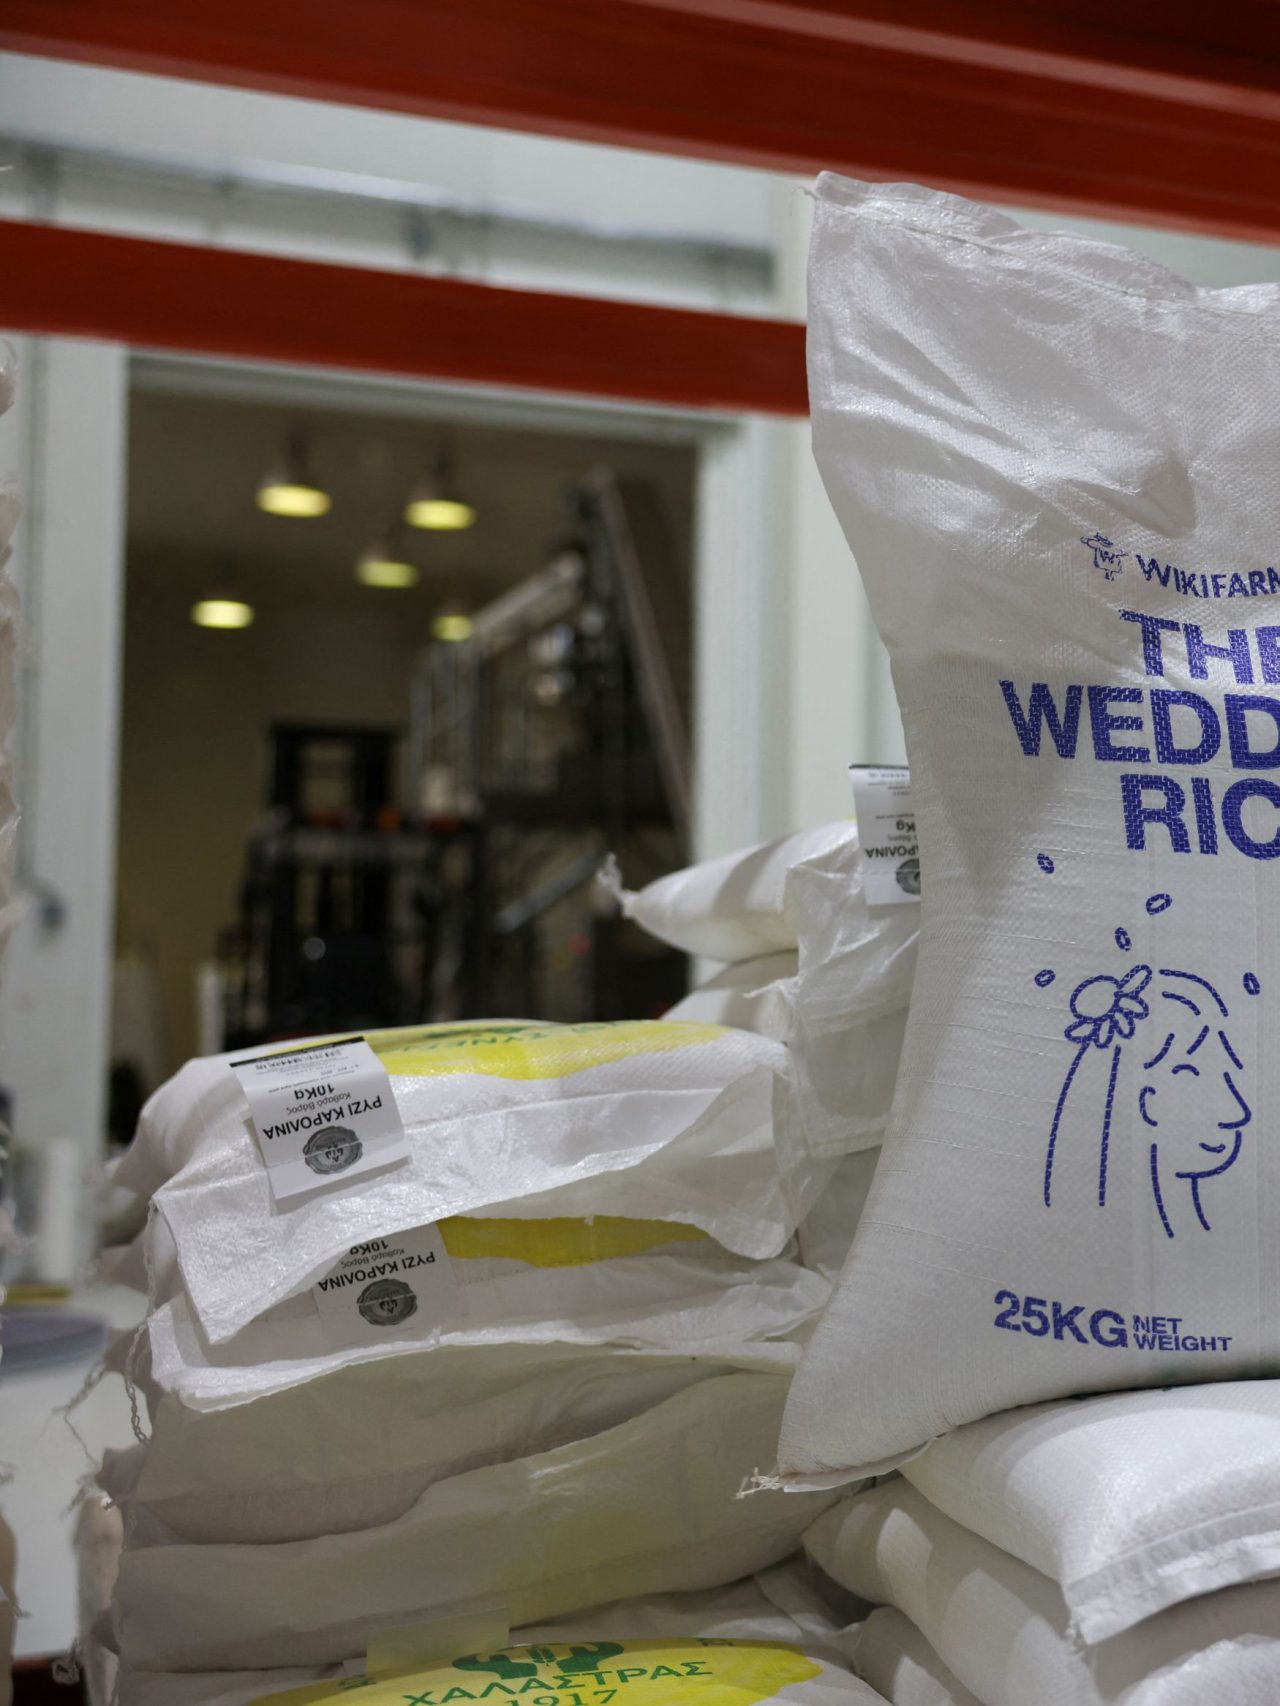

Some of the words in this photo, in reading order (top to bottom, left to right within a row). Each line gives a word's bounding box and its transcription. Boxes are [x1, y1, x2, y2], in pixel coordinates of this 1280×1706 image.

[350, 1095, 382, 1116] ΡΥΖΙ
[262, 1106, 345, 1140] ΚΑΡΟΛΙΝΑ
[402, 1251, 436, 1270] ΡΥΖΙ
[318, 1261, 399, 1292] ΚΑΡΟΛΙΝΑ
[993, 1289, 1128, 1348] 25KG
[1133, 1315, 1183, 1335] NET
[1133, 1333, 1232, 1351] WEIGHT
[402, 1661, 713, 1706] ΧΑΛΑΣΤΡΑΣ
